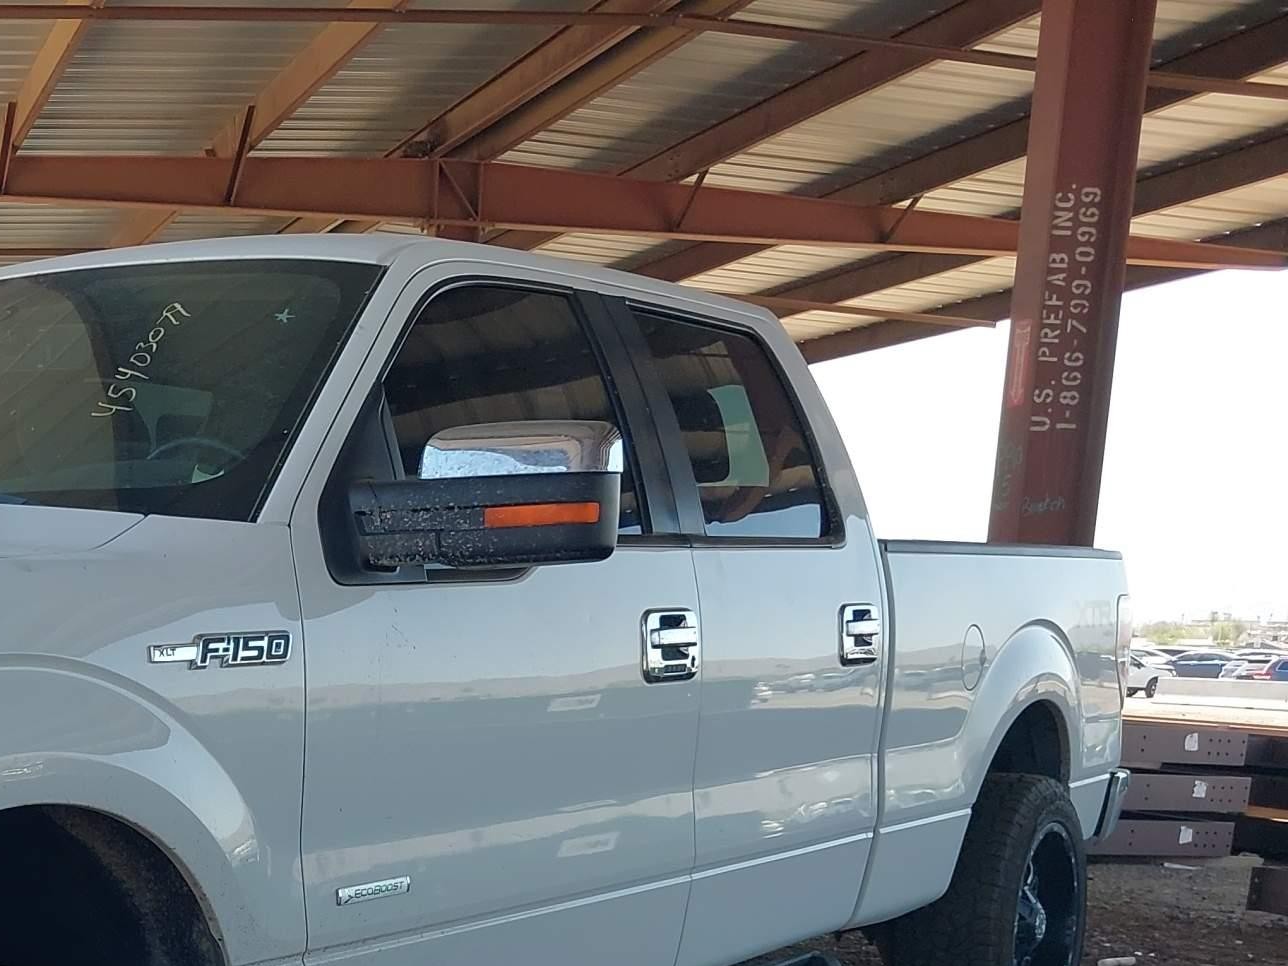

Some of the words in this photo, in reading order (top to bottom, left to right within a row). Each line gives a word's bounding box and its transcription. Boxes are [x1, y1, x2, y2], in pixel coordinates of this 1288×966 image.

[1051, 183, 1077, 237] INC.
[1037, 252, 1069, 363] PREFAB
[1055, 186, 1102, 431] 1-866-799-0969
[1029, 379, 1056, 432] U.S.
[157, 648, 177, 657] XLT
[197, 633, 293, 667] F-150
